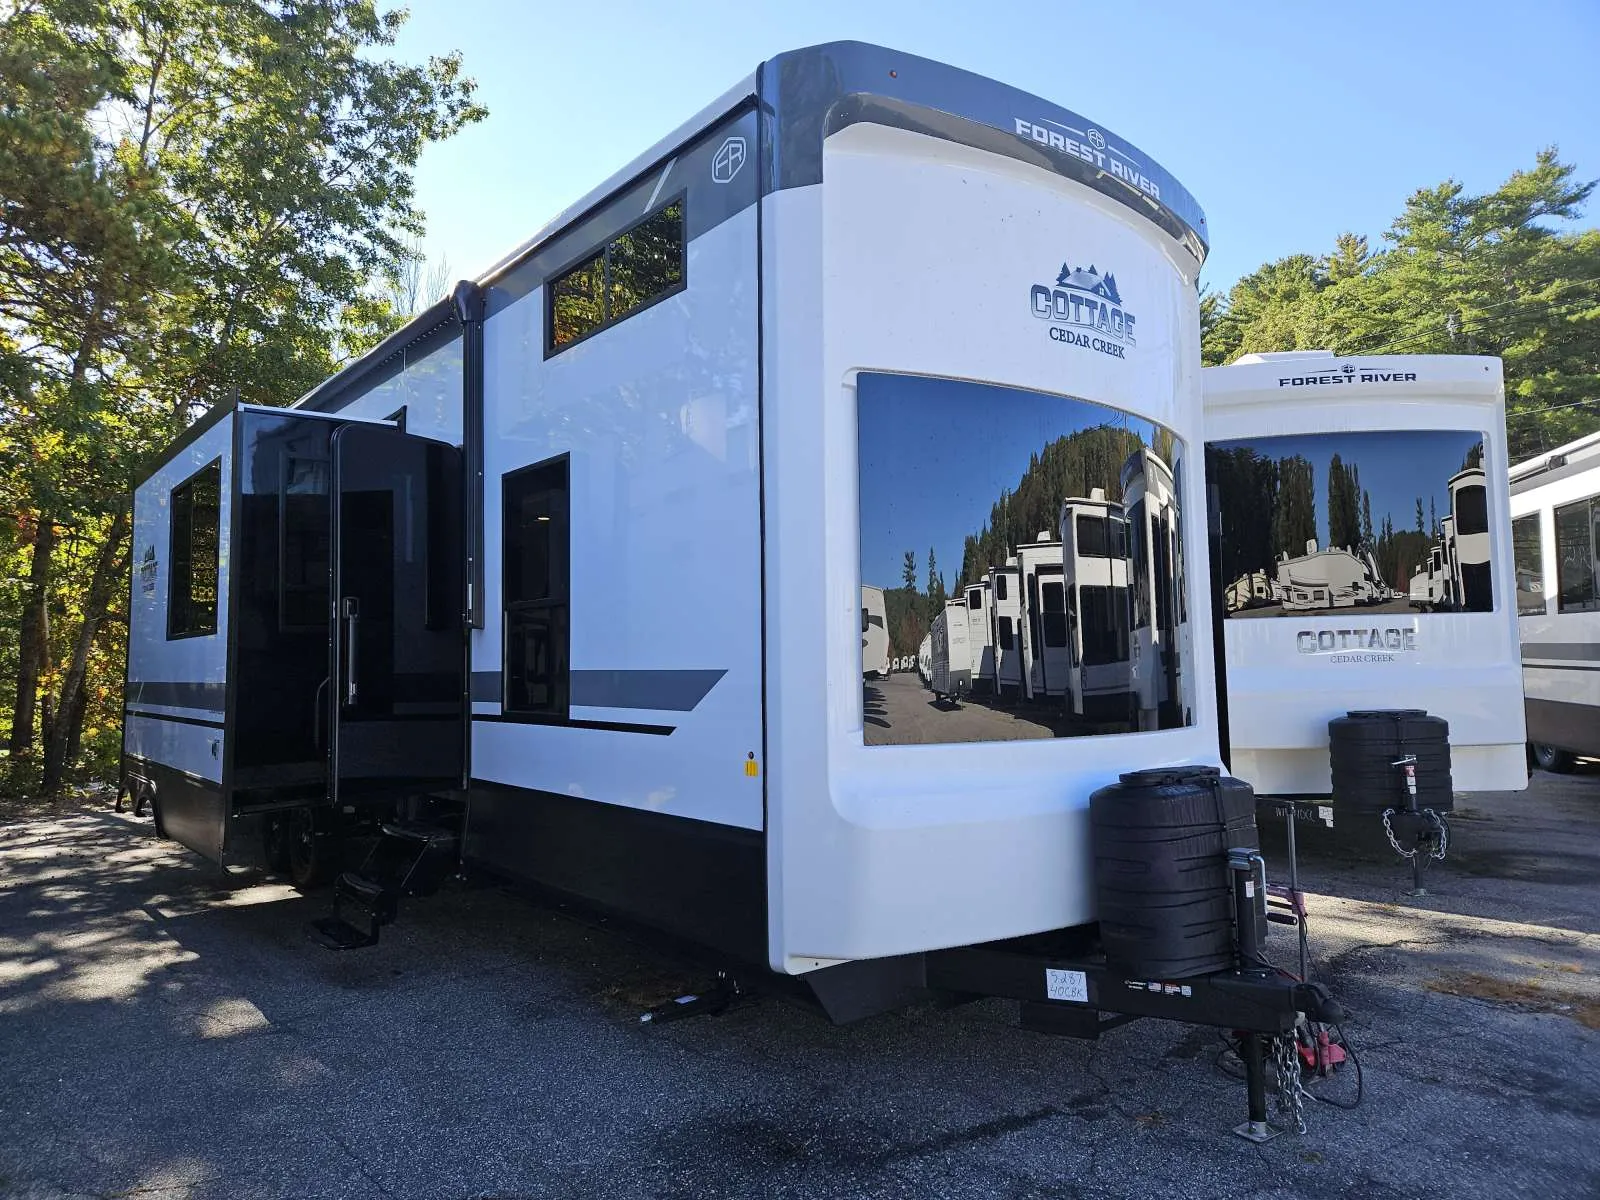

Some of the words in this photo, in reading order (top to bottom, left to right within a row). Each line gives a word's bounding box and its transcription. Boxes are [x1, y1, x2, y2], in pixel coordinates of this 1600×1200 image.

[1014, 117, 1106, 169] FOREST
[1110, 159, 1161, 200] RIVER
[1030, 284, 1137, 345] COTTAGE
[1049, 327, 1090, 349] CEDAR
[1092, 338, 1126, 360] CREEK
[1279, 375, 1356, 387] FOREST
[1360, 373, 1417, 383] RIVER
[1296, 627, 1417, 654] COTTAGE
[1330, 655, 1362, 664] CEDAR
[1363, 654, 1395, 663] CREEK
